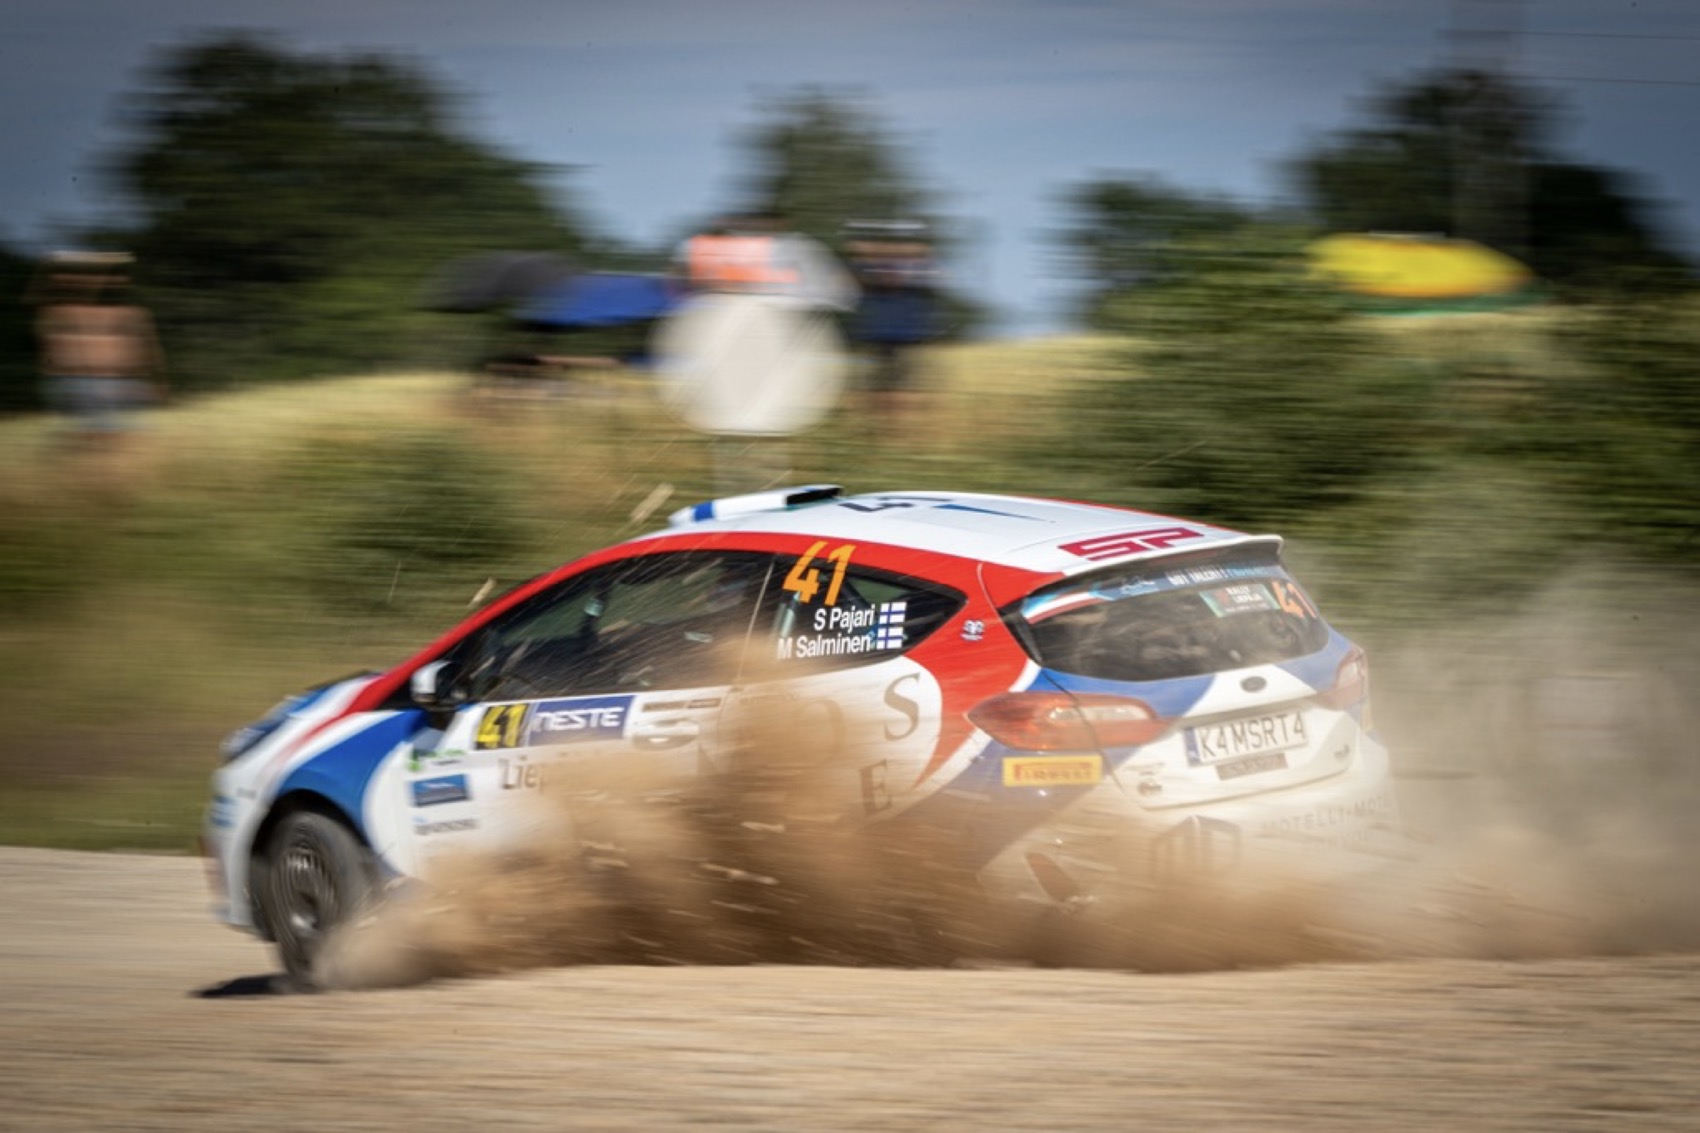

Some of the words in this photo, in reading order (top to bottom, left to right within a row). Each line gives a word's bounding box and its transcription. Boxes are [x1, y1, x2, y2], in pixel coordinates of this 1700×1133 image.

[782, 541, 856, 606] 41
[814, 608, 826, 631] S
[829, 604, 875, 634] Pajari
[776, 638, 792, 660] M
[796, 633, 871, 659] Salminen
[476, 703, 528, 748] 41
